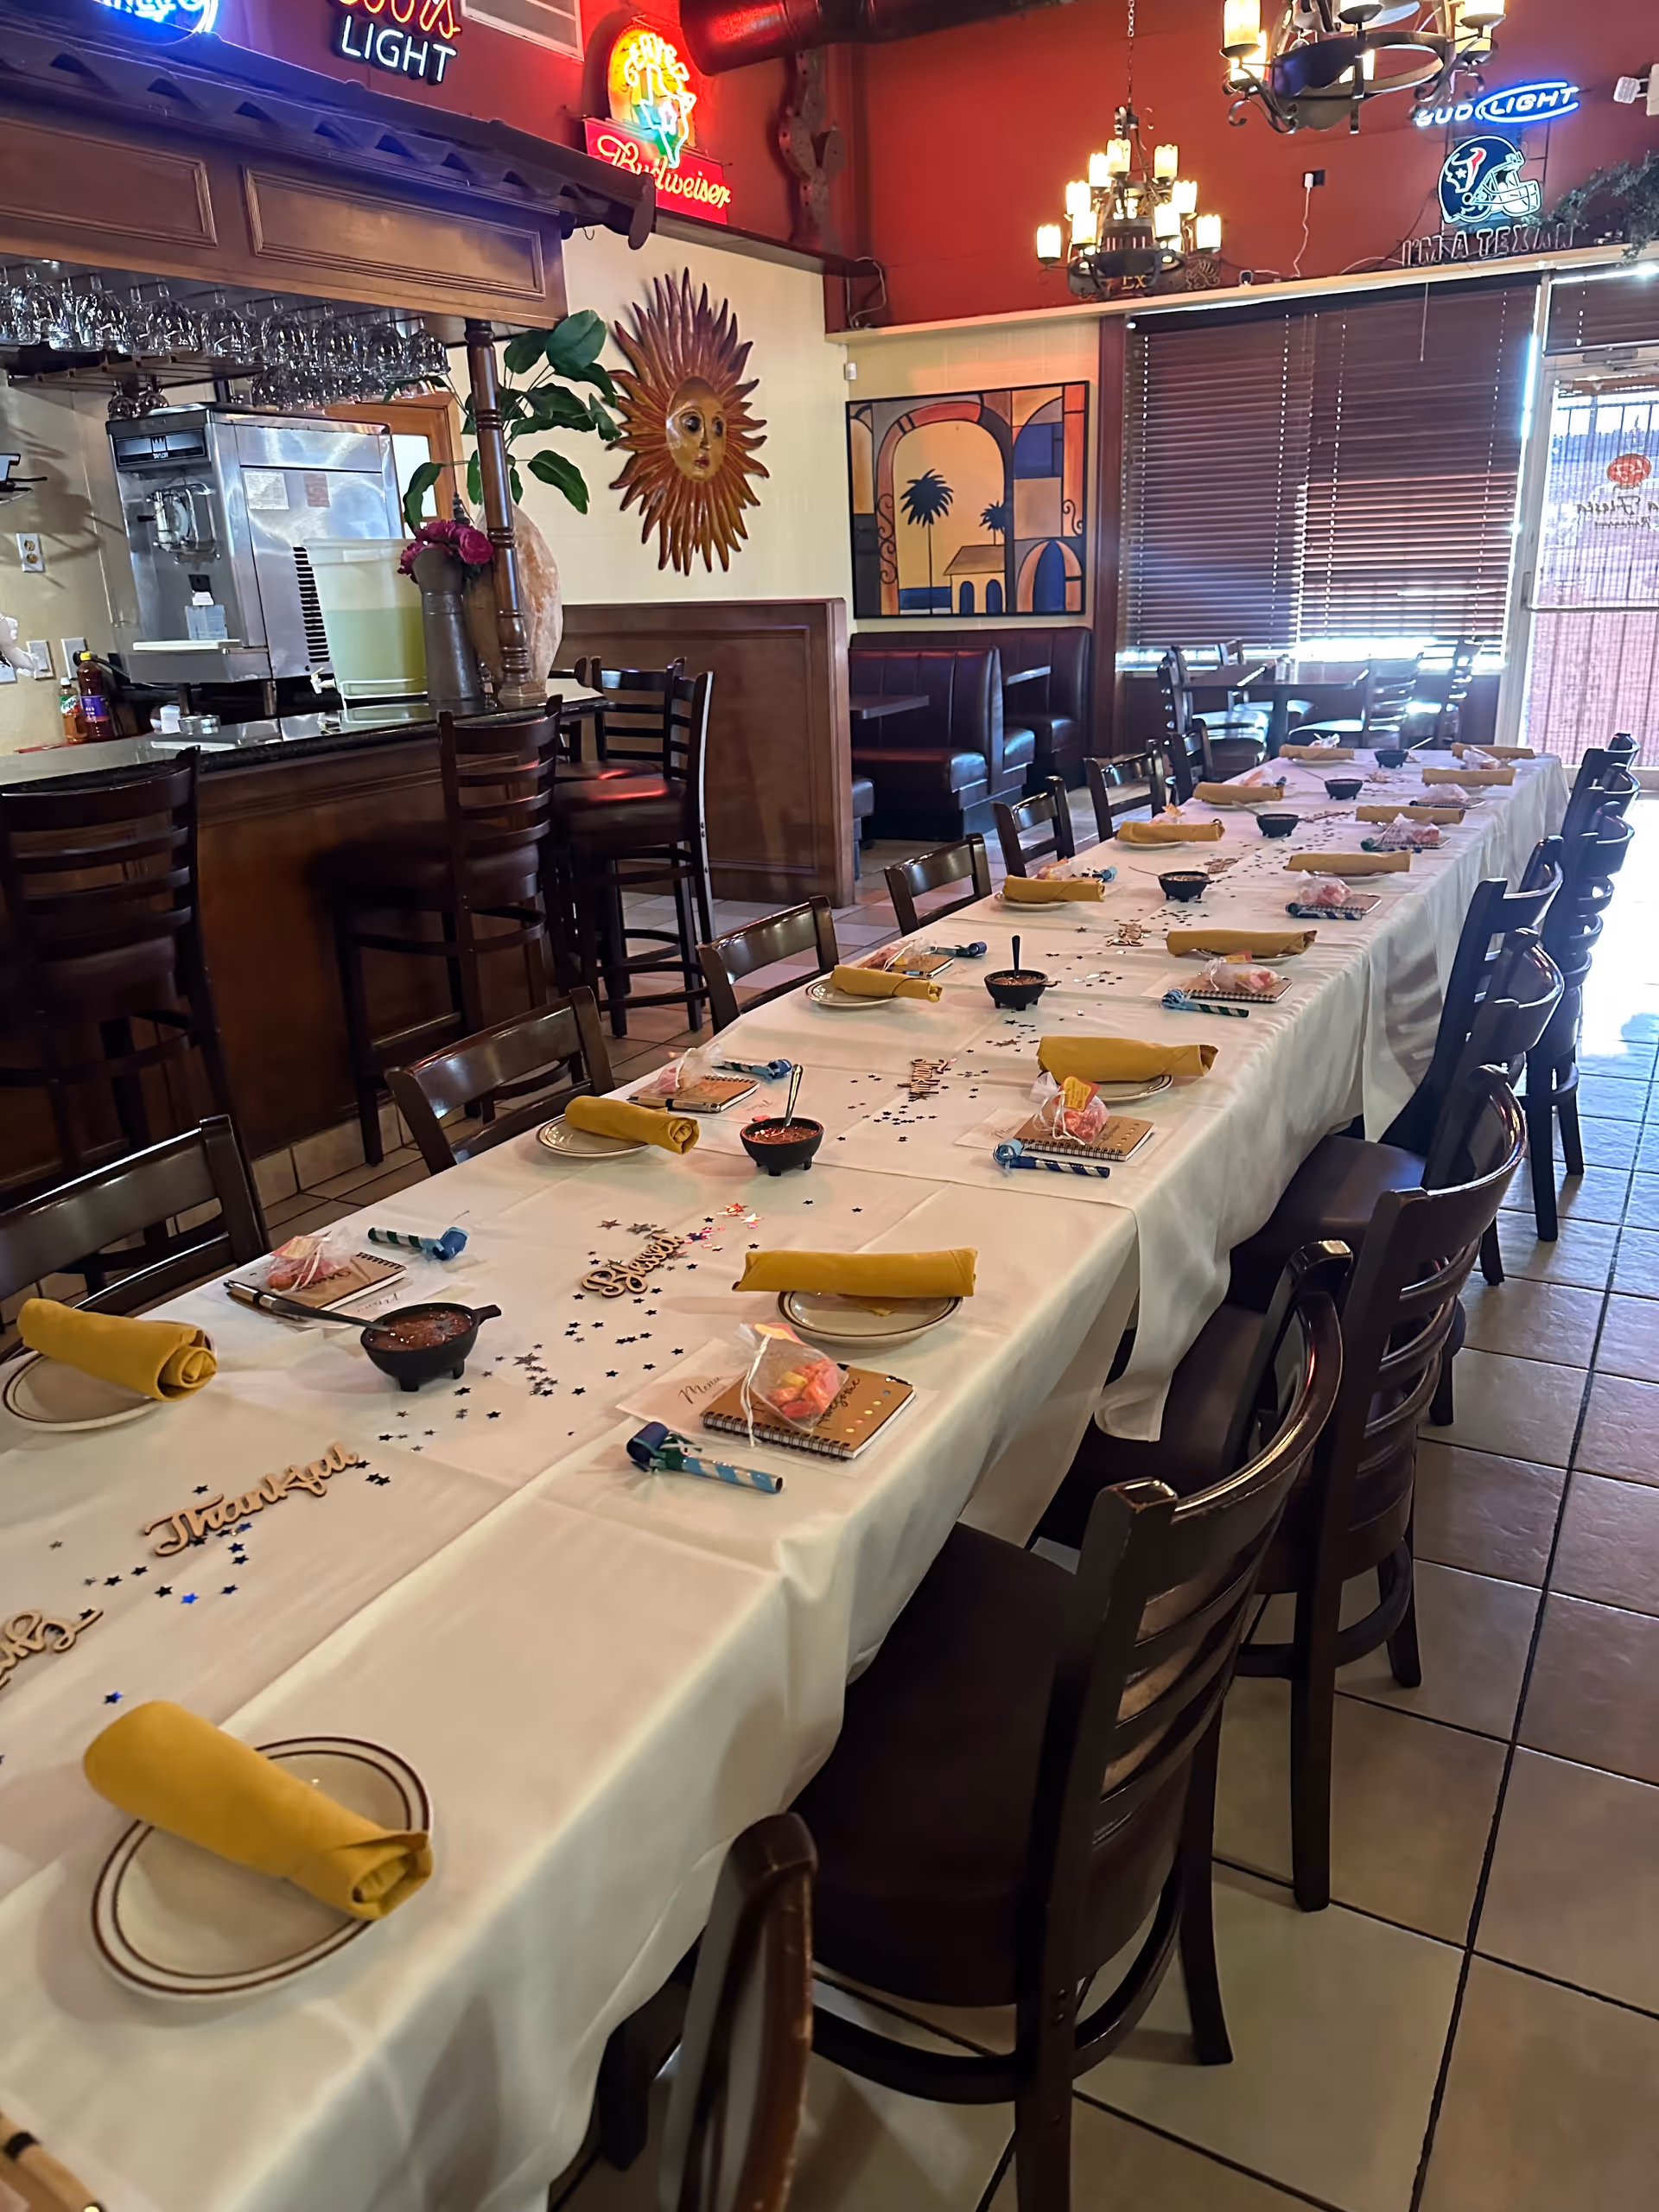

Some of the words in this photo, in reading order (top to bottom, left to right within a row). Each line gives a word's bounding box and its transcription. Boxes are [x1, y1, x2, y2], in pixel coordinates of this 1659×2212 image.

[341, 15, 457, 82] LIGHT
[1415, 105, 1473, 128] BUD
[1490, 86, 1580, 116] LIGHT
[1451, 230, 1470, 259] A
[1476, 222, 1574, 259] TEXAN
[581, 1233, 686, 1299] Blessed
[677, 1375, 723, 1406] Menu
[142, 1442, 359, 1557] Thankful
